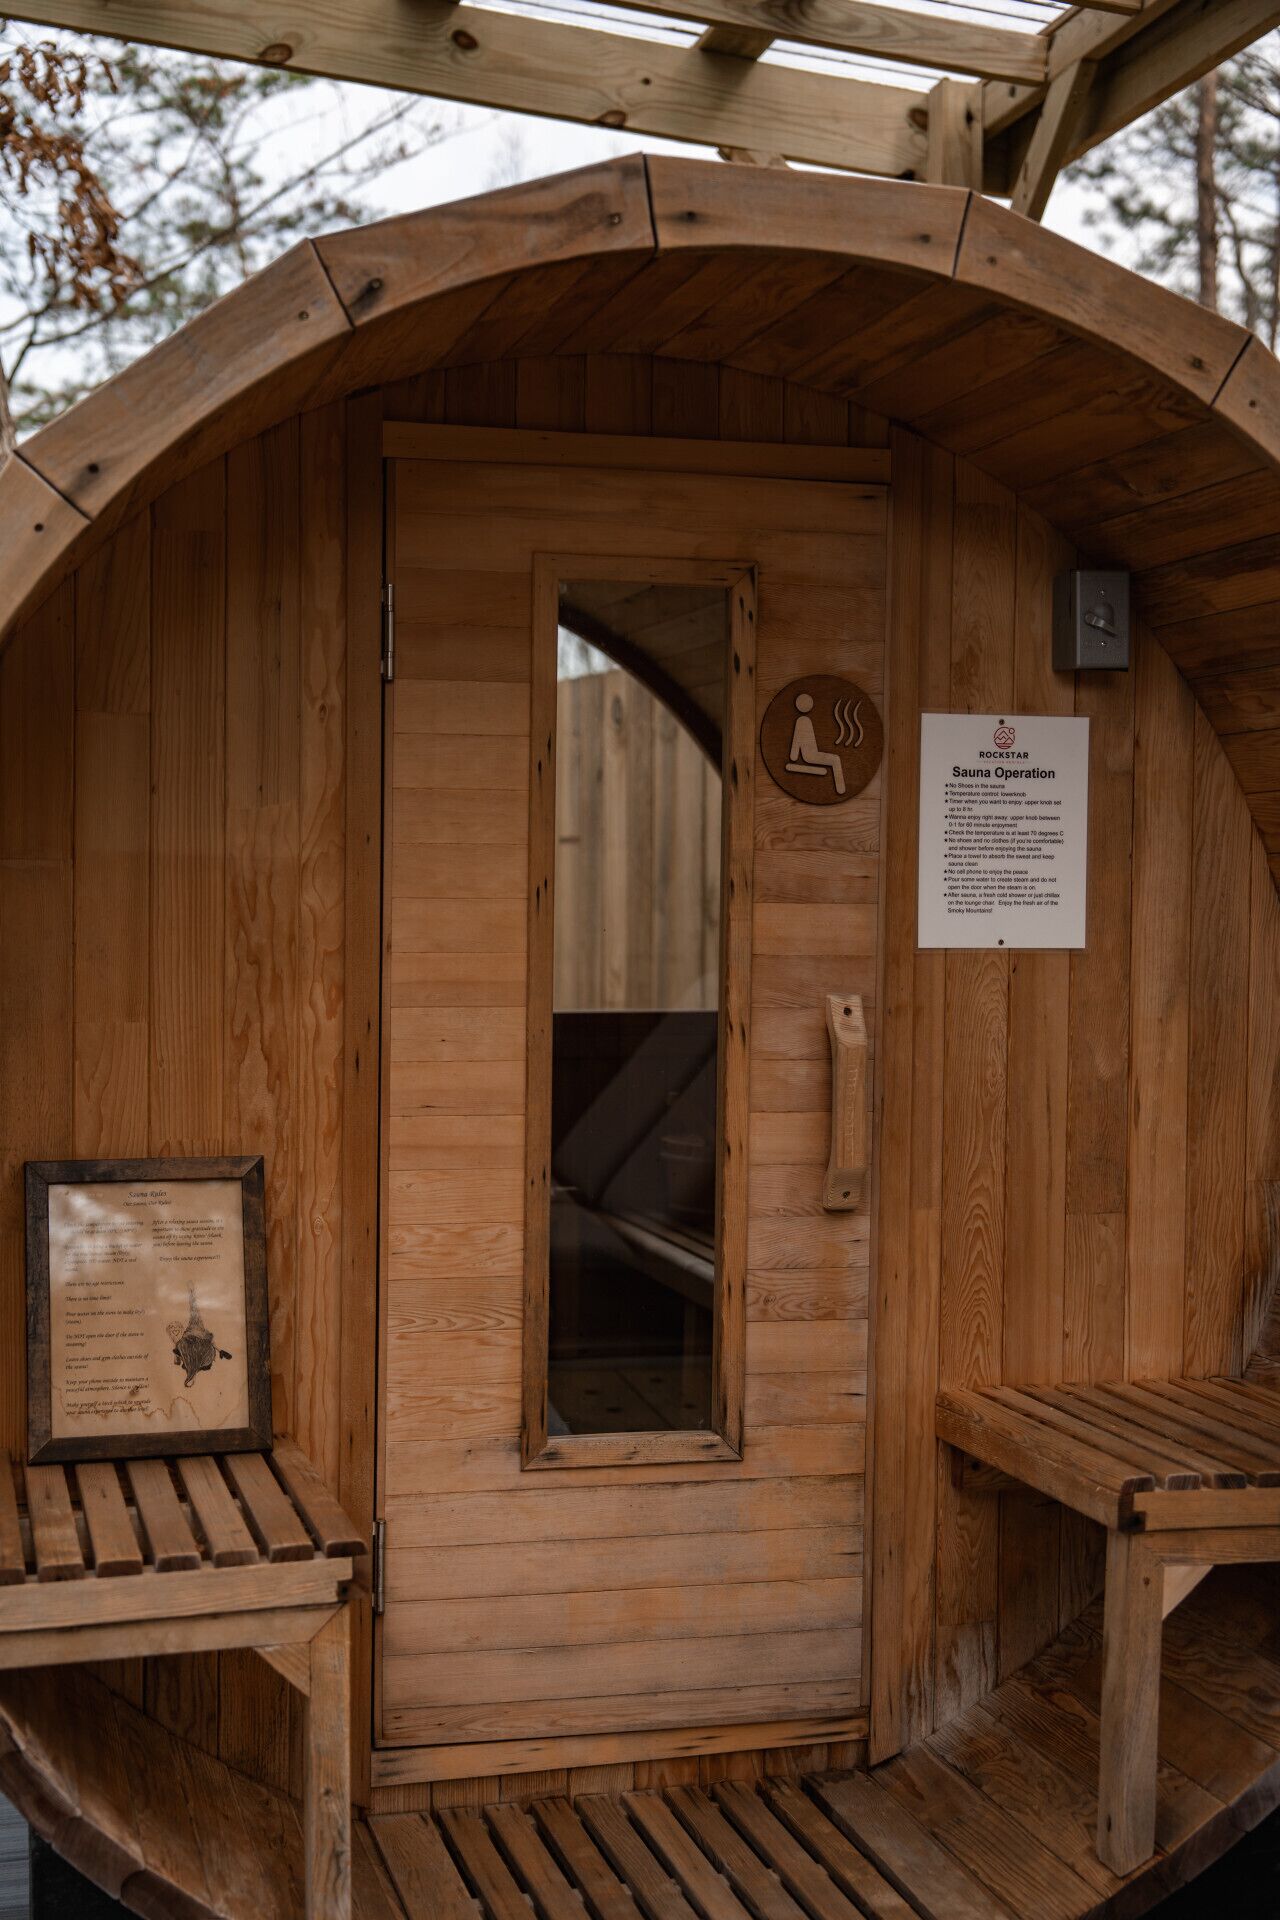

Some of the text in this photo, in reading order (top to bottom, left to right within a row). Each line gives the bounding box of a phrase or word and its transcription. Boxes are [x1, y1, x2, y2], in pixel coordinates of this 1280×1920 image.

[979, 751, 1029, 759] ROCKSTAR
[952, 766, 1055, 780] Sauna Operation
